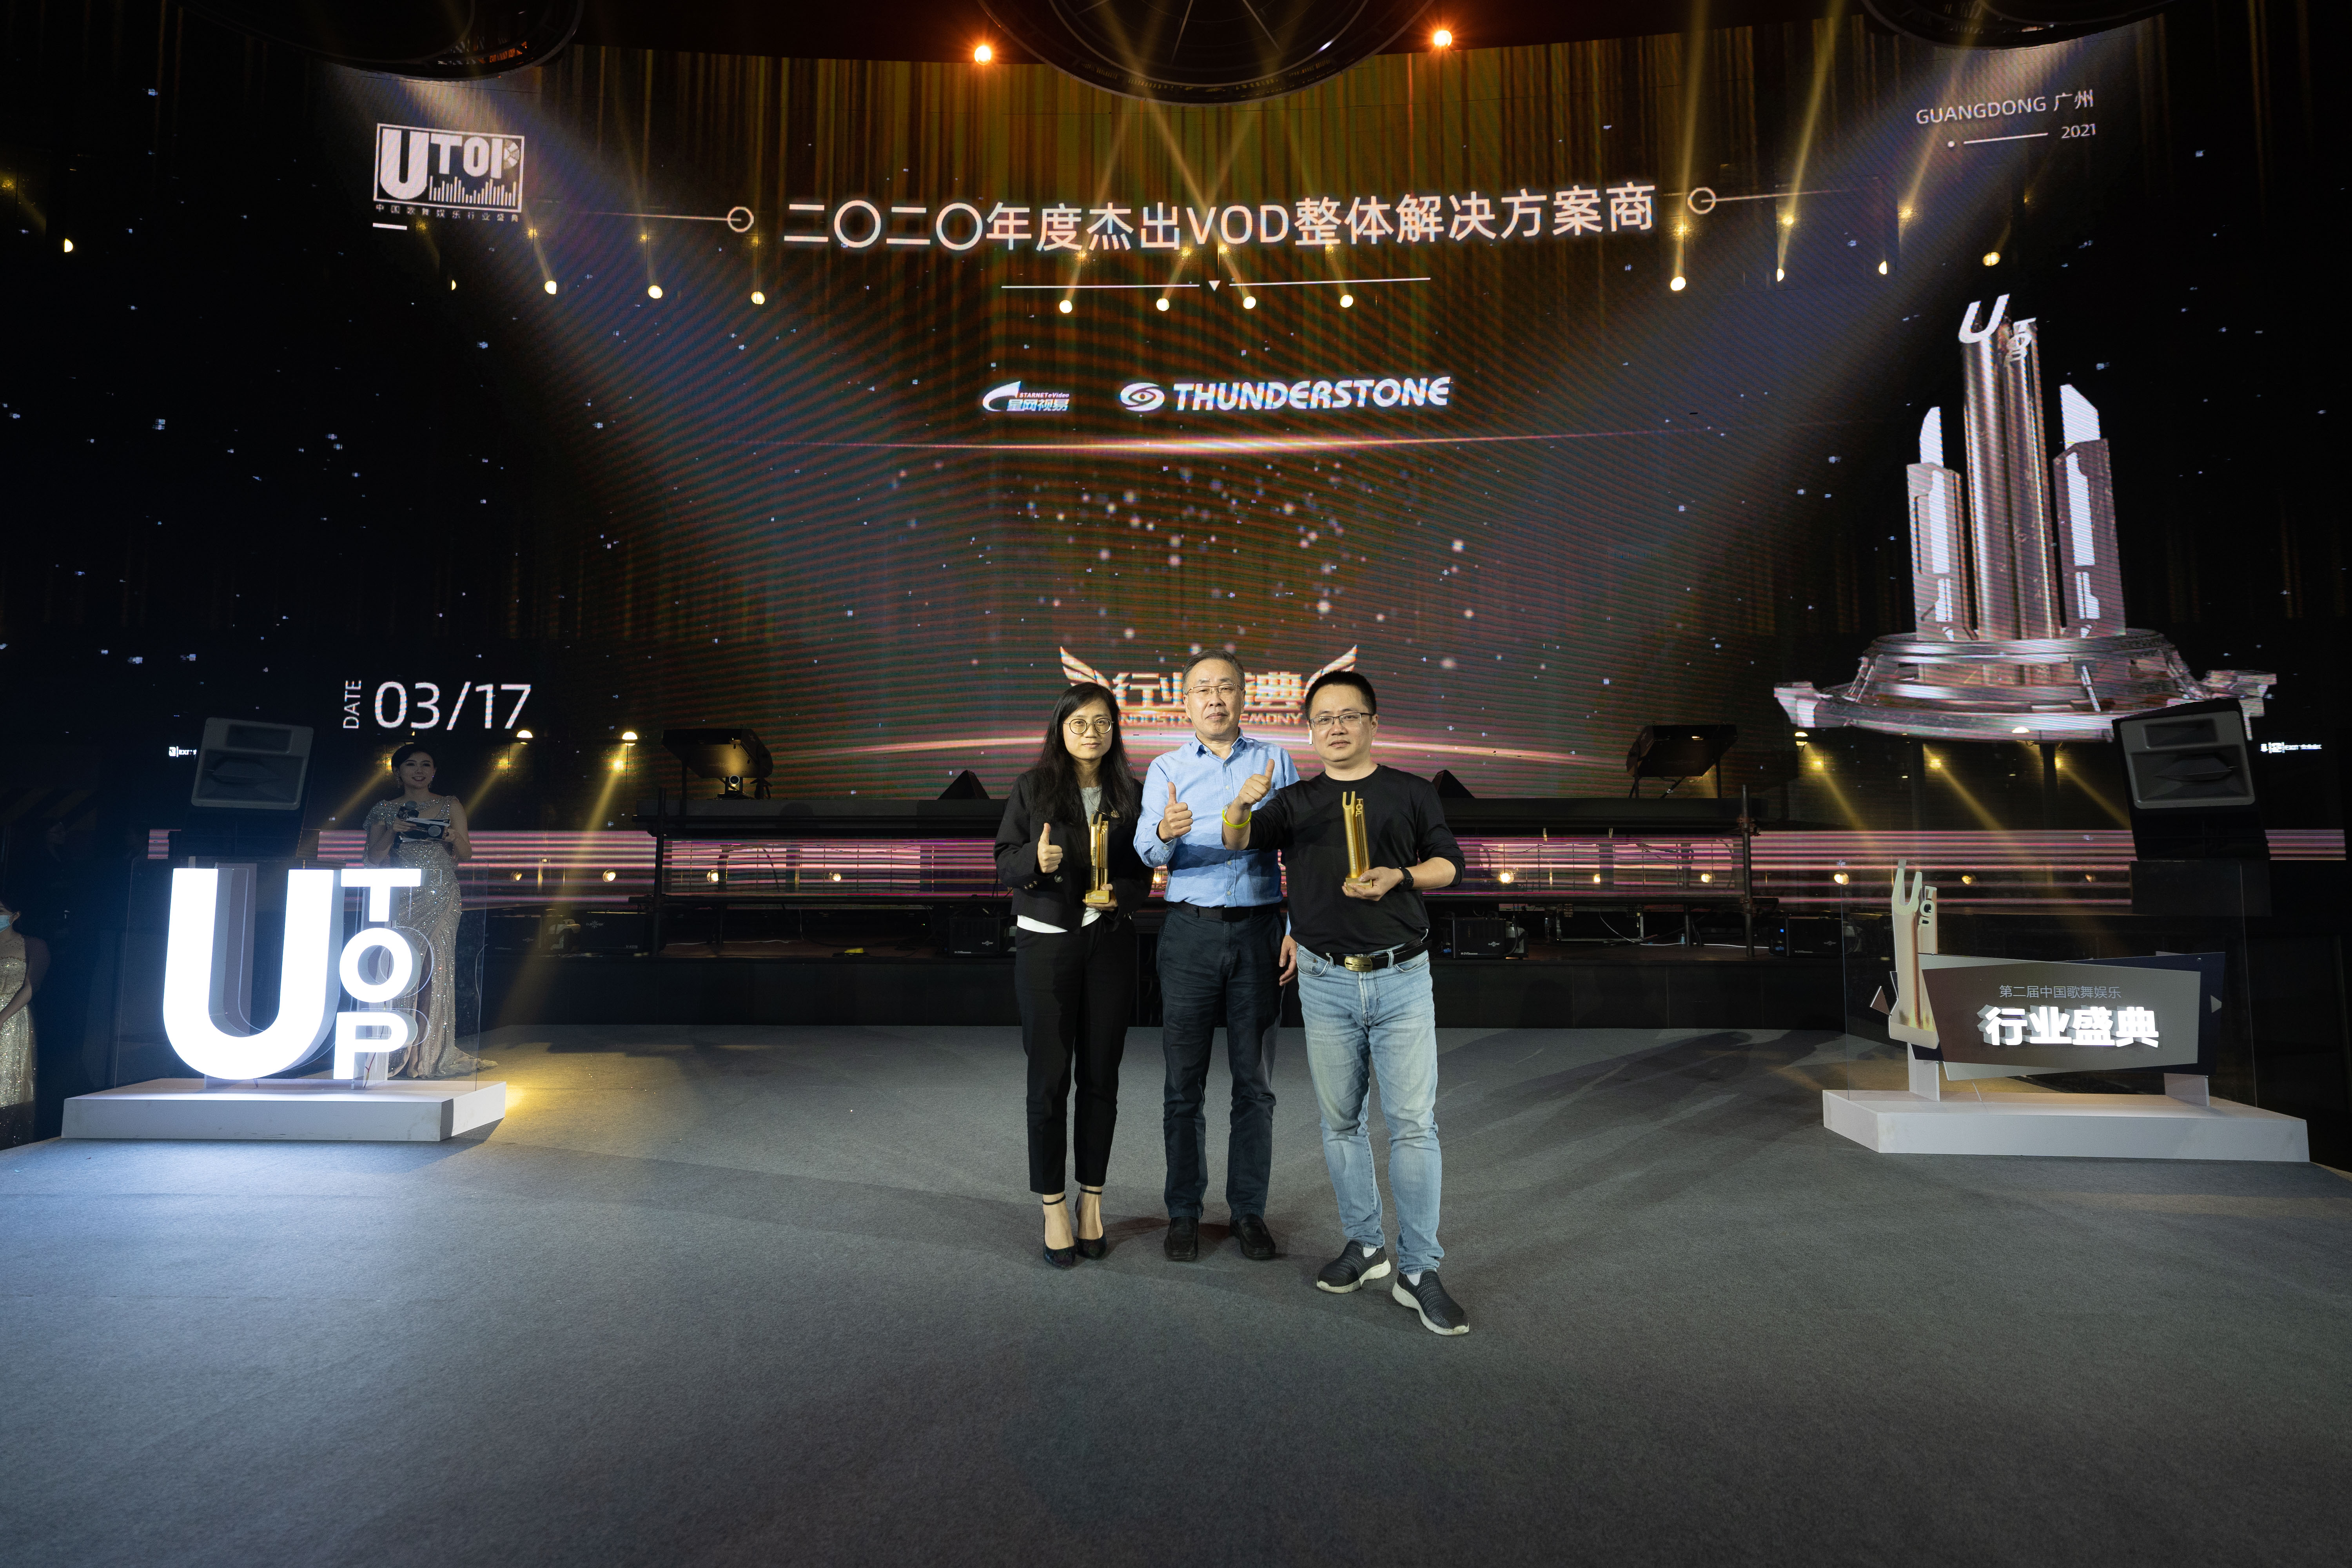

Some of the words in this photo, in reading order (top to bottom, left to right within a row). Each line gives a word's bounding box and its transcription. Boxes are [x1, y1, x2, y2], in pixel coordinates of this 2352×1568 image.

[1916, 96, 2046, 124] GUANGDONG
[2053, 89, 2093, 111] 广州
[2061, 123, 2096, 139] 2021
[1006, 399, 1070, 411] 星网视易
[1174, 377, 1450, 411] THUNDERSTONE
[343, 680, 361, 729] DATE
[375, 681, 531, 730] 03/17
[1999, 985, 2122, 999] 第二届中国歌舞娱乐
[1984, 1006, 2159, 1047] 行业盛典
